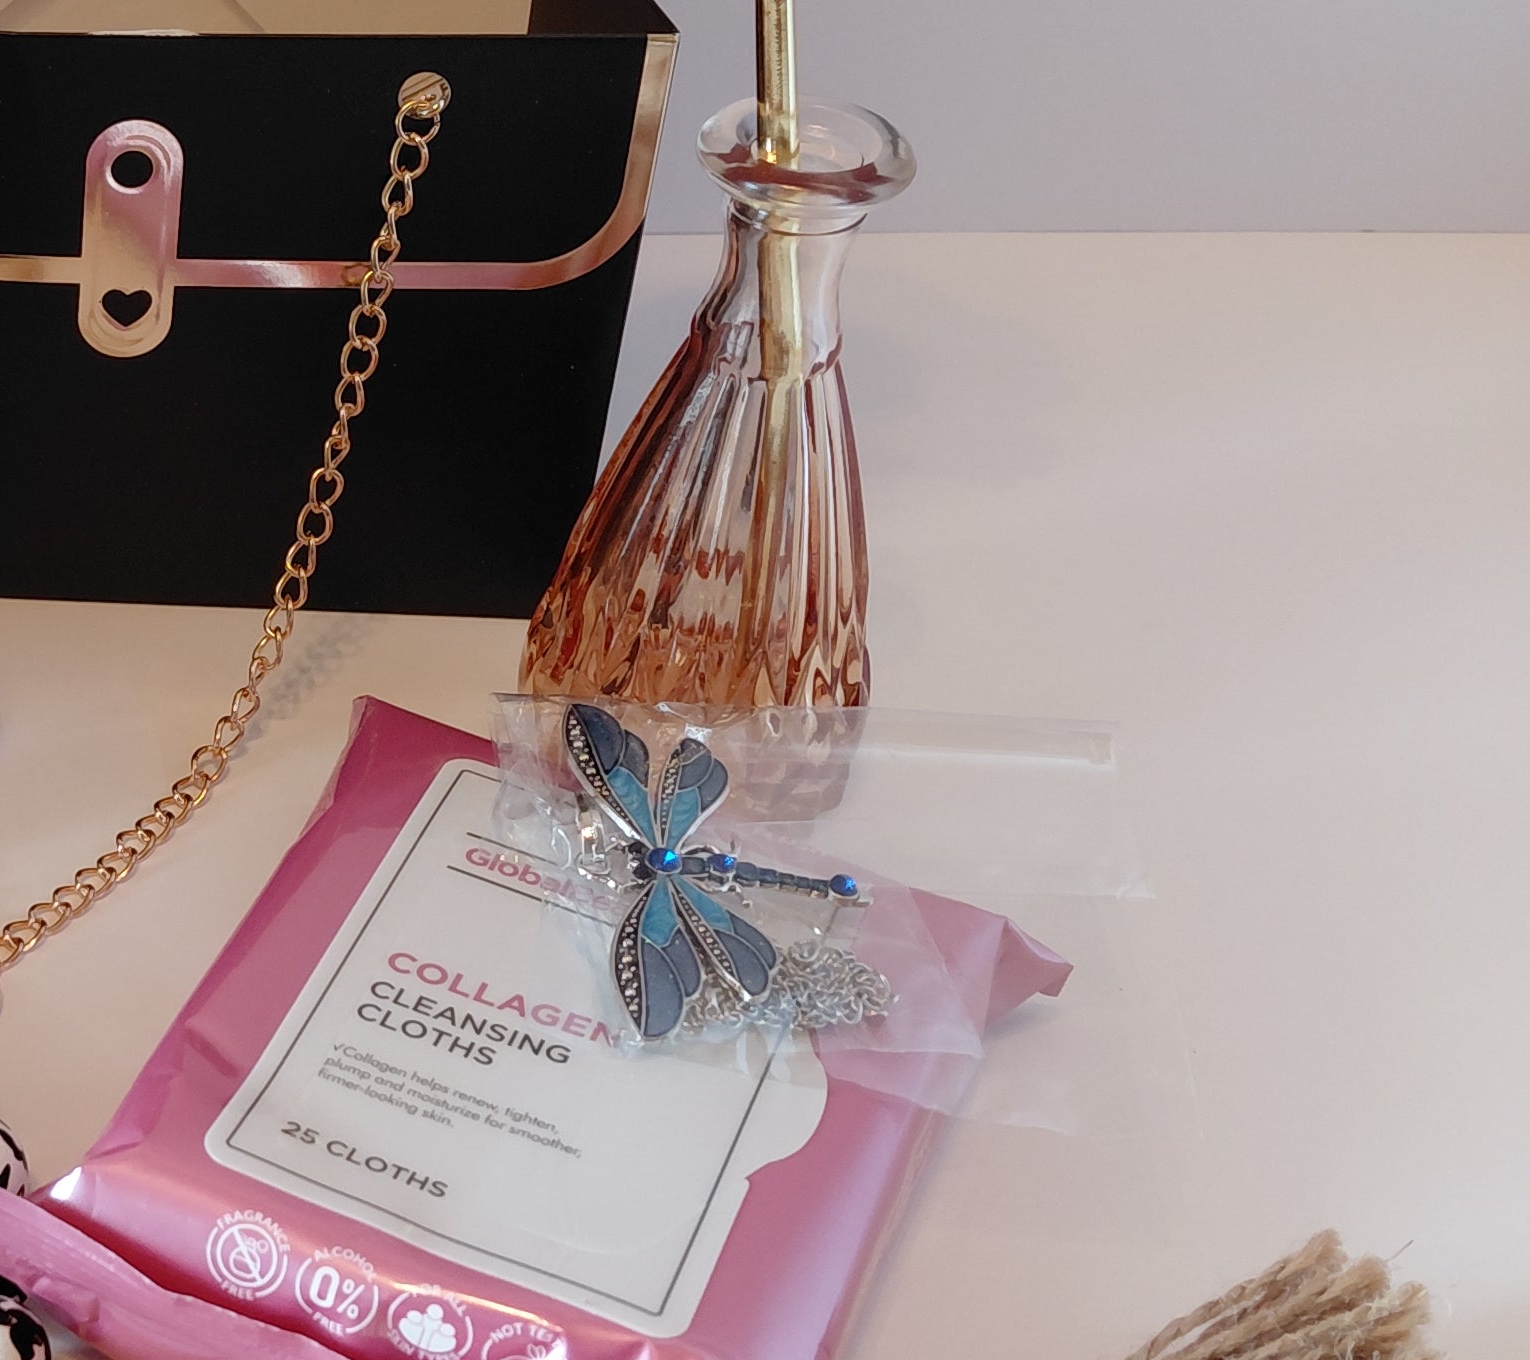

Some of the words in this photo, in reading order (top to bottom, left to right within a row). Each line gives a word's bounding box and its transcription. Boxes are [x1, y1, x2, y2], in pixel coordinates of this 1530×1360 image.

[357, 1003, 496, 1066] CLOTHS
[371, 981, 572, 1064] CLEANSING
[318, 1067, 419, 1115] firmer-looking
[422, 1107, 454, 1129] skin.
[324, 1056, 372, 1081] plump
[374, 1075, 405, 1093] and
[407, 1088, 481, 1122] moisturize
[484, 1113, 505, 1131] for
[509, 1126, 582, 1159] smoother,
[411, 1070, 450, 1094] helps
[453, 1090, 500, 1114] renew,
[505, 1106, 560, 1134] tighten,
[281, 1120, 320, 1145] 25
[326, 1140, 449, 1198] CLOTHS
[216, 1209, 291, 1252] FRAGRANCE
[221, 1282, 254, 1301] FREE
[309, 1266, 366, 1320] 0%
[314, 1245, 377, 1283] ALCOHOL
[312, 1311, 344, 1337] FREE
[490, 1322, 523, 1343] NOT
